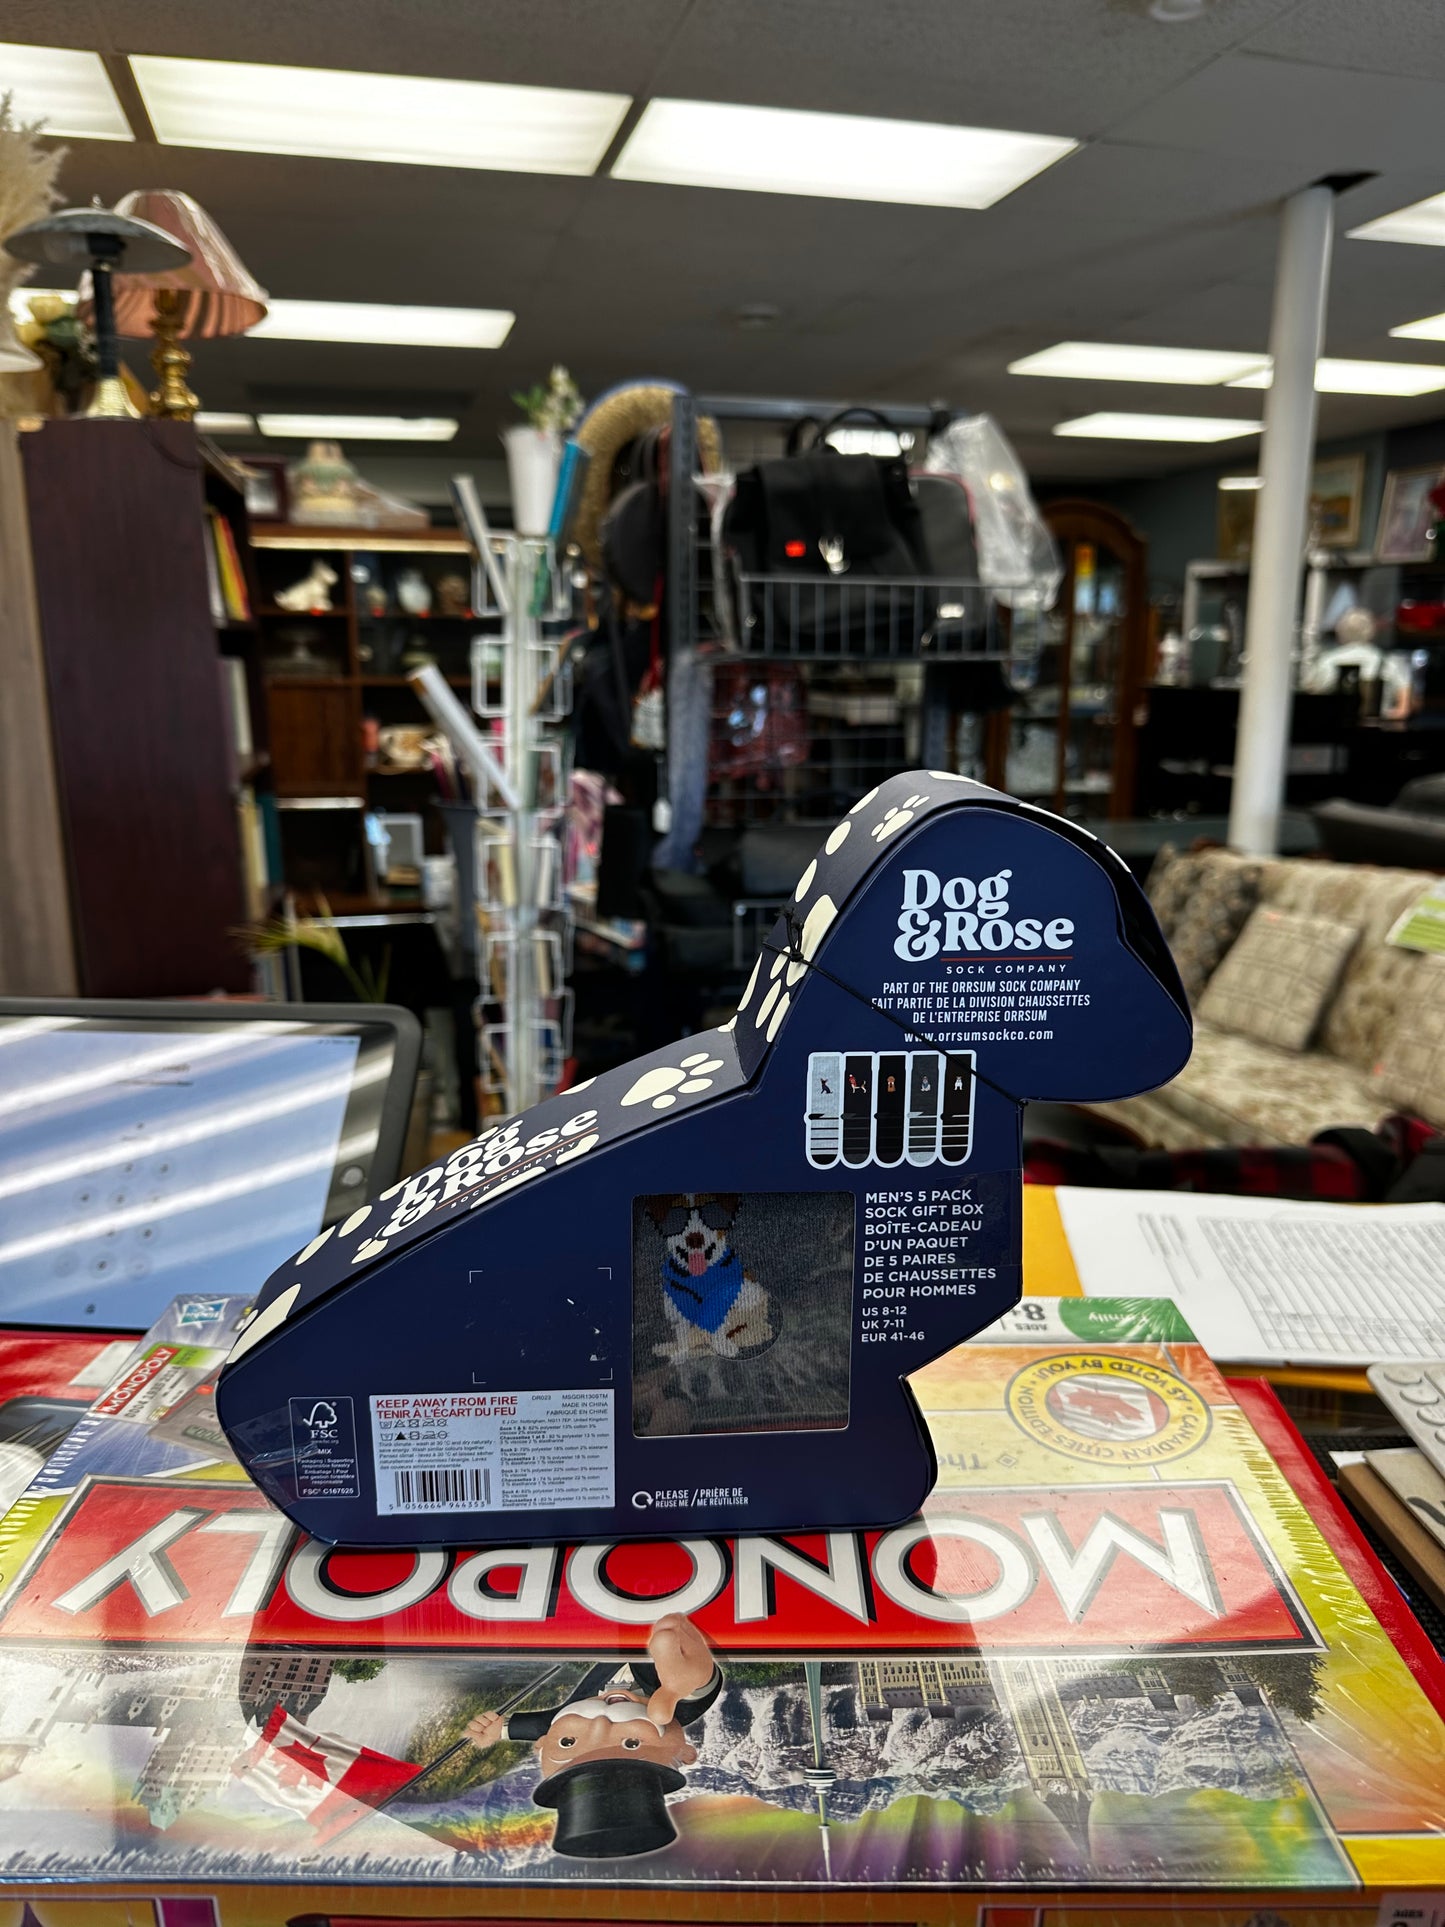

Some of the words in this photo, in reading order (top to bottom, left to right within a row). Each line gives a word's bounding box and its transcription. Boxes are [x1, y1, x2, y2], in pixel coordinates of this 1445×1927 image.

[901, 869, 1012, 919] Dog
[894, 909, 1075, 962] &Rose
[946, 965, 985, 974] SOCK
[995, 964, 1067, 974] COMPANY
[883, 982, 909, 994] PART
[912, 982, 926, 994] OF
[929, 981, 949, 993] THE
[952, 980, 996, 993] ORRSUM
[999, 980, 1027, 992] SOCK
[1030, 980, 1081, 992] COMPANY
[871, 997, 894, 1009] FAIT
[897, 997, 933, 1009] PARTIE
[936, 997, 950, 1009] DE
[953, 996, 966, 1008] LA
[969, 996, 1015, 1008] DIVISION
[1018, 994, 1091, 1007] CHAUSSETTES
[913, 1011, 926, 1023] DE
[929, 1011, 1001, 1023] L'ENTREPRISE
[1004, 1009, 1048, 1022] ORRSUM
[396, 1119, 524, 1208] Dog
[450, 1183, 491, 1209] SOCK
[500, 1141, 576, 1182] COMPANY
[865, 1191, 914, 1203] MEN’S
[917, 1191, 927, 1202] 5
[931, 1189, 972, 1202] PACK
[865, 1206, 908, 1219] SOCK
[912, 1205, 947, 1217] GIFT
[952, 1203, 985, 1216] BOX
[865, 1219, 982, 1236] BOÎTE-CADEAU
[907, 1236, 969, 1250] PAQUET
[864, 1256, 885, 1268] DE
[889, 1255, 898, 1266] 5
[902, 1253, 956, 1266] PAIRES
[863, 1271, 885, 1283] DE
[888, 1268, 997, 1282] CHAUSSETTES
[863, 1287, 906, 1299] POUR
[909, 1284, 977, 1298] HOMMES
[862, 1306, 880, 1317] US
[882, 1305, 908, 1316] 8-12
[861, 1319, 879, 1329] UK
[882, 1318, 905, 1328] 7-11
[1015, 1322, 1048, 1331] AGES
[861, 1332, 887, 1342] EUR
[890, 1330, 925, 1341] 41-46
[1034, 1360, 1079, 1381] YOU!
[1080, 1358, 1104, 1369] BY
[1108, 1360, 1169, 1389] VOTED
[1166, 1384, 1192, 1403] AS
[376, 1398, 410, 1409] KEEP
[412, 1398, 448, 1408] AWAY
[451, 1397, 487, 1407] FROM
[490, 1396, 518, 1405] FIRE
[376, 1409, 411, 1419] TENIR
[413, 1407, 422, 1418] À
[424, 1406, 473, 1418] L'ÉCART
[474, 1407, 491, 1417] DU
[493, 1406, 517, 1416] FEU
[1019, 1385, 1052, 1435] EDITION
[310, 1429, 339, 1439] FSC
[1124, 1414, 1197, 1460] CANADIAN
[1054, 1433, 1114, 1459] CITIES
[655, 1490, 689, 1500] PLEASE
[700, 1486, 730, 1498] PRIÈRE
[732, 1487, 743, 1497] DE
[655, 1500, 677, 1508] REUSE
[678, 1499, 689, 1507] ME
[697, 1498, 708, 1506] ME
[710, 1496, 749, 1506] RÉUTILISER
[51, 1509, 1224, 1624] MONOPOLY
